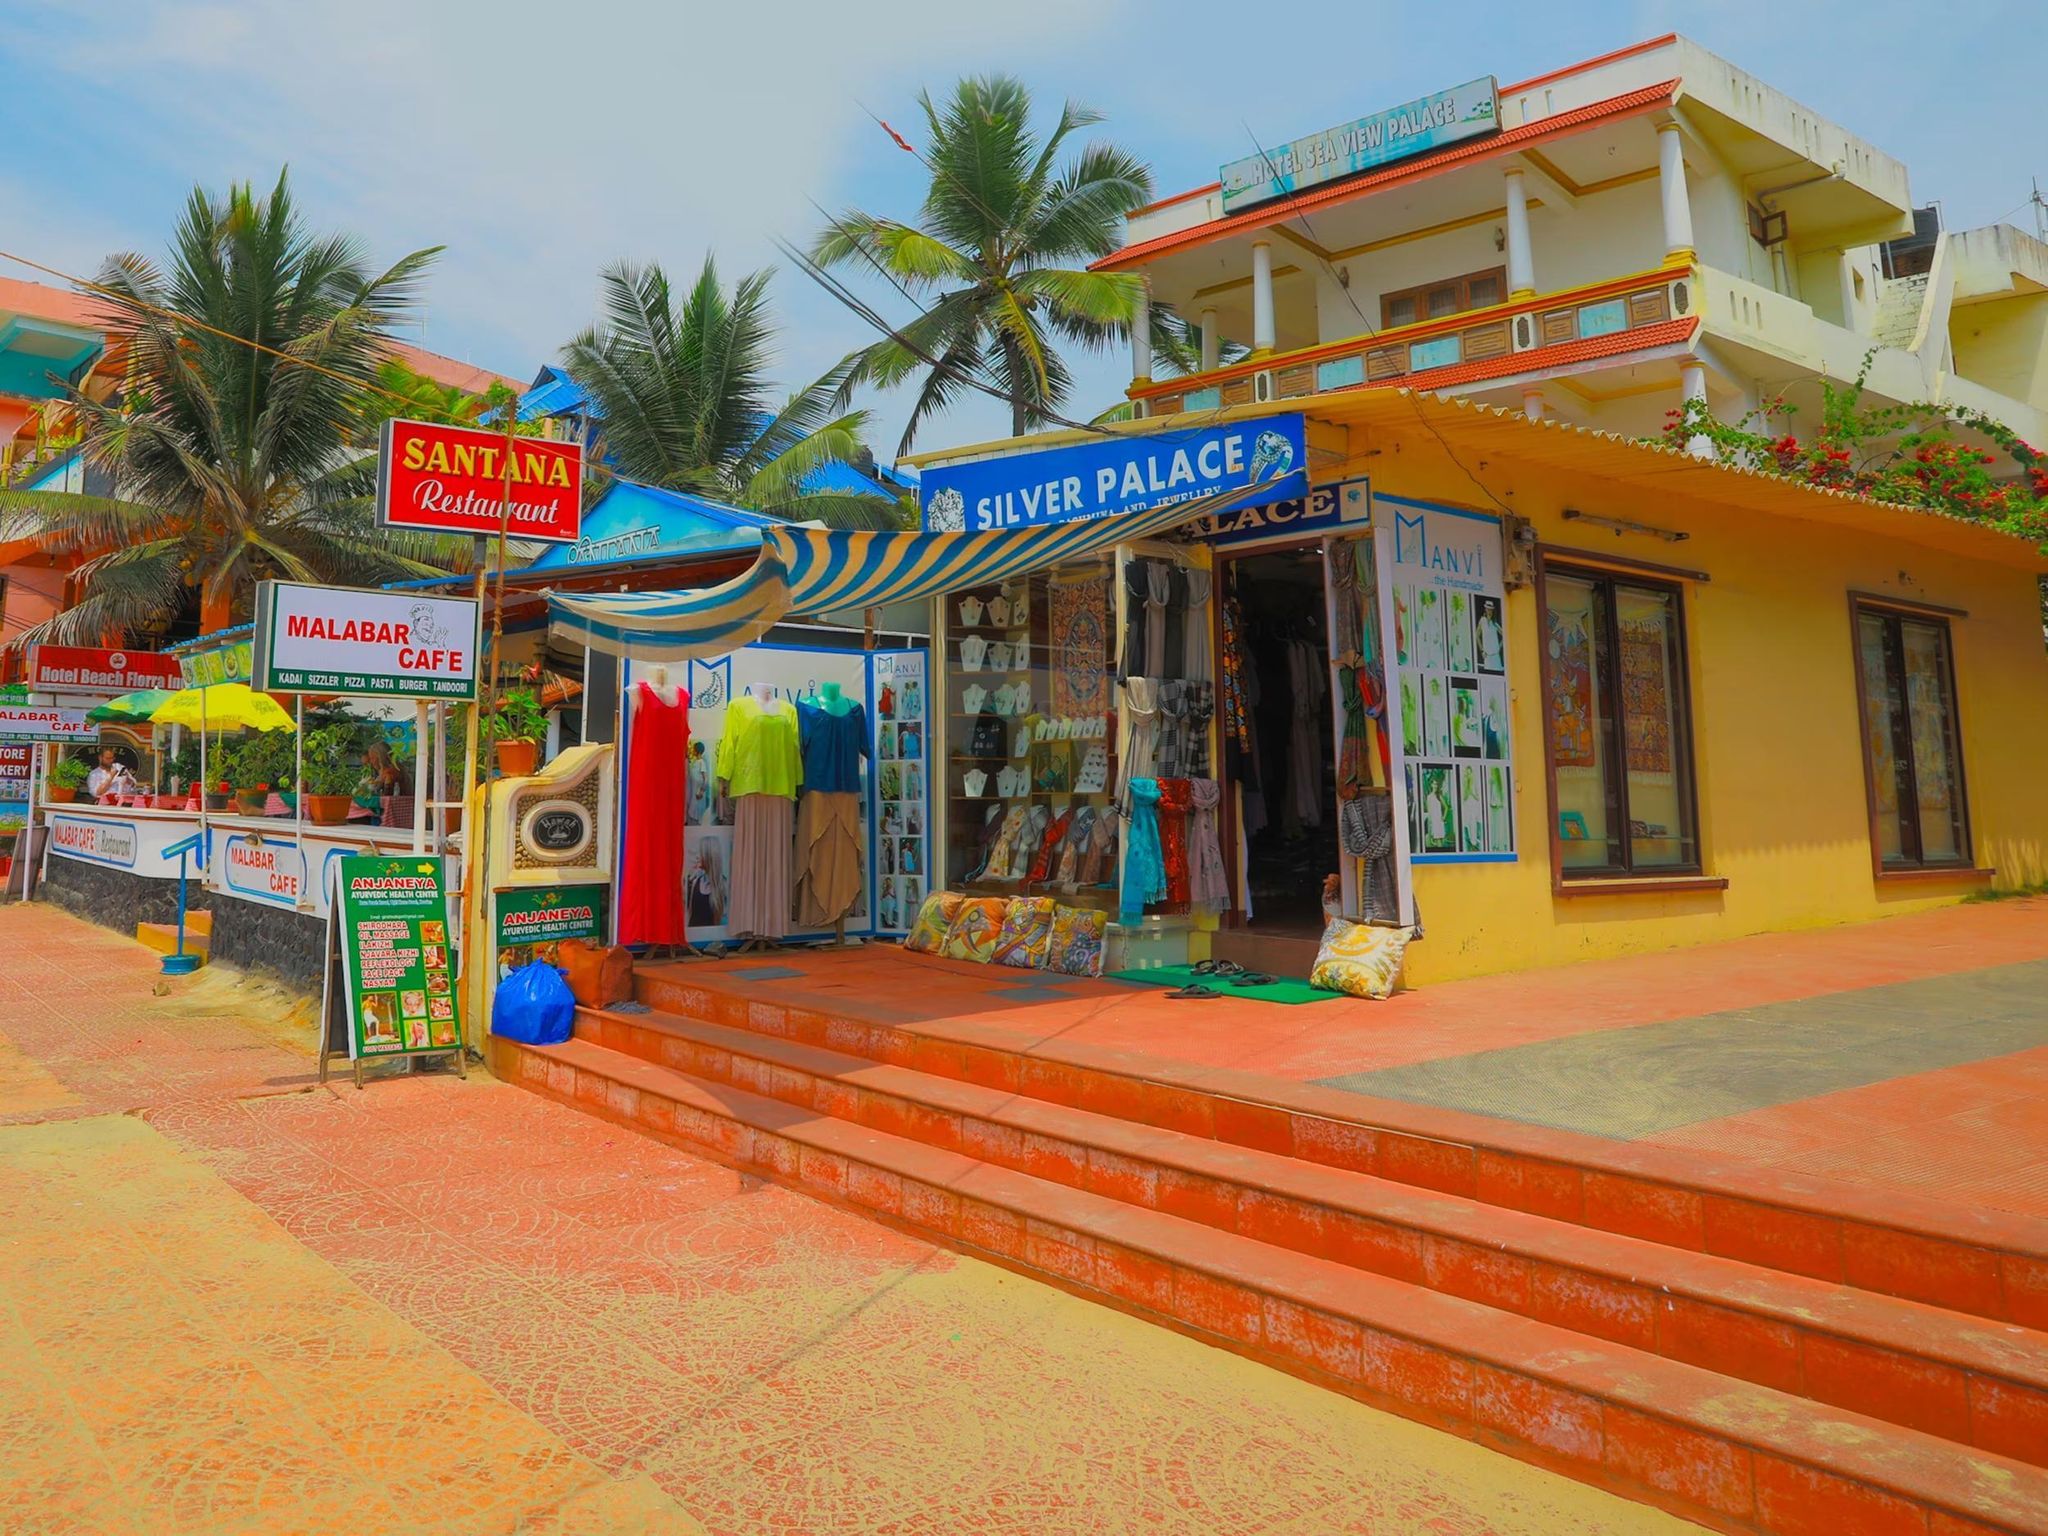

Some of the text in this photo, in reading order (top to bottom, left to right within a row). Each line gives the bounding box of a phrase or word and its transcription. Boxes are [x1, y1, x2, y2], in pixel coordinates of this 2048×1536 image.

[1252, 97, 1457, 185] HOTEL SEA VIEW PALACE
[402, 437, 571, 488] SANTANA
[976, 434, 1245, 531] SILVER PALACE
[412, 479, 559, 524] Restaurant
[1123, 501, 1147, 514] AND
[287, 614, 411, 645] MALABAR
[40, 666, 78, 684] Hotel
[81, 668, 124, 687] Beach
[278, 672, 468, 693] KADAI SIZZLER PIZZA PASTA BURGER TANDOORI
[231, 847, 274, 871] MALABAR
[351, 877, 437, 890] ANJANEYA
[351, 890, 439, 899] AYURVEDIC HEALTH CENTRE
[502, 906, 593, 926] ANJANEYA
[357, 921, 408, 931] SHIRODHARA
[358, 930, 411, 940] OIL MASSAGE
[502, 920, 593, 936] AYURVEDIC HEALTH CENTRE
[361, 958, 416, 969] REFLEXOLOGY
[361, 968, 406, 978] FACE PACK
[362, 978, 397, 988] NASYAM
